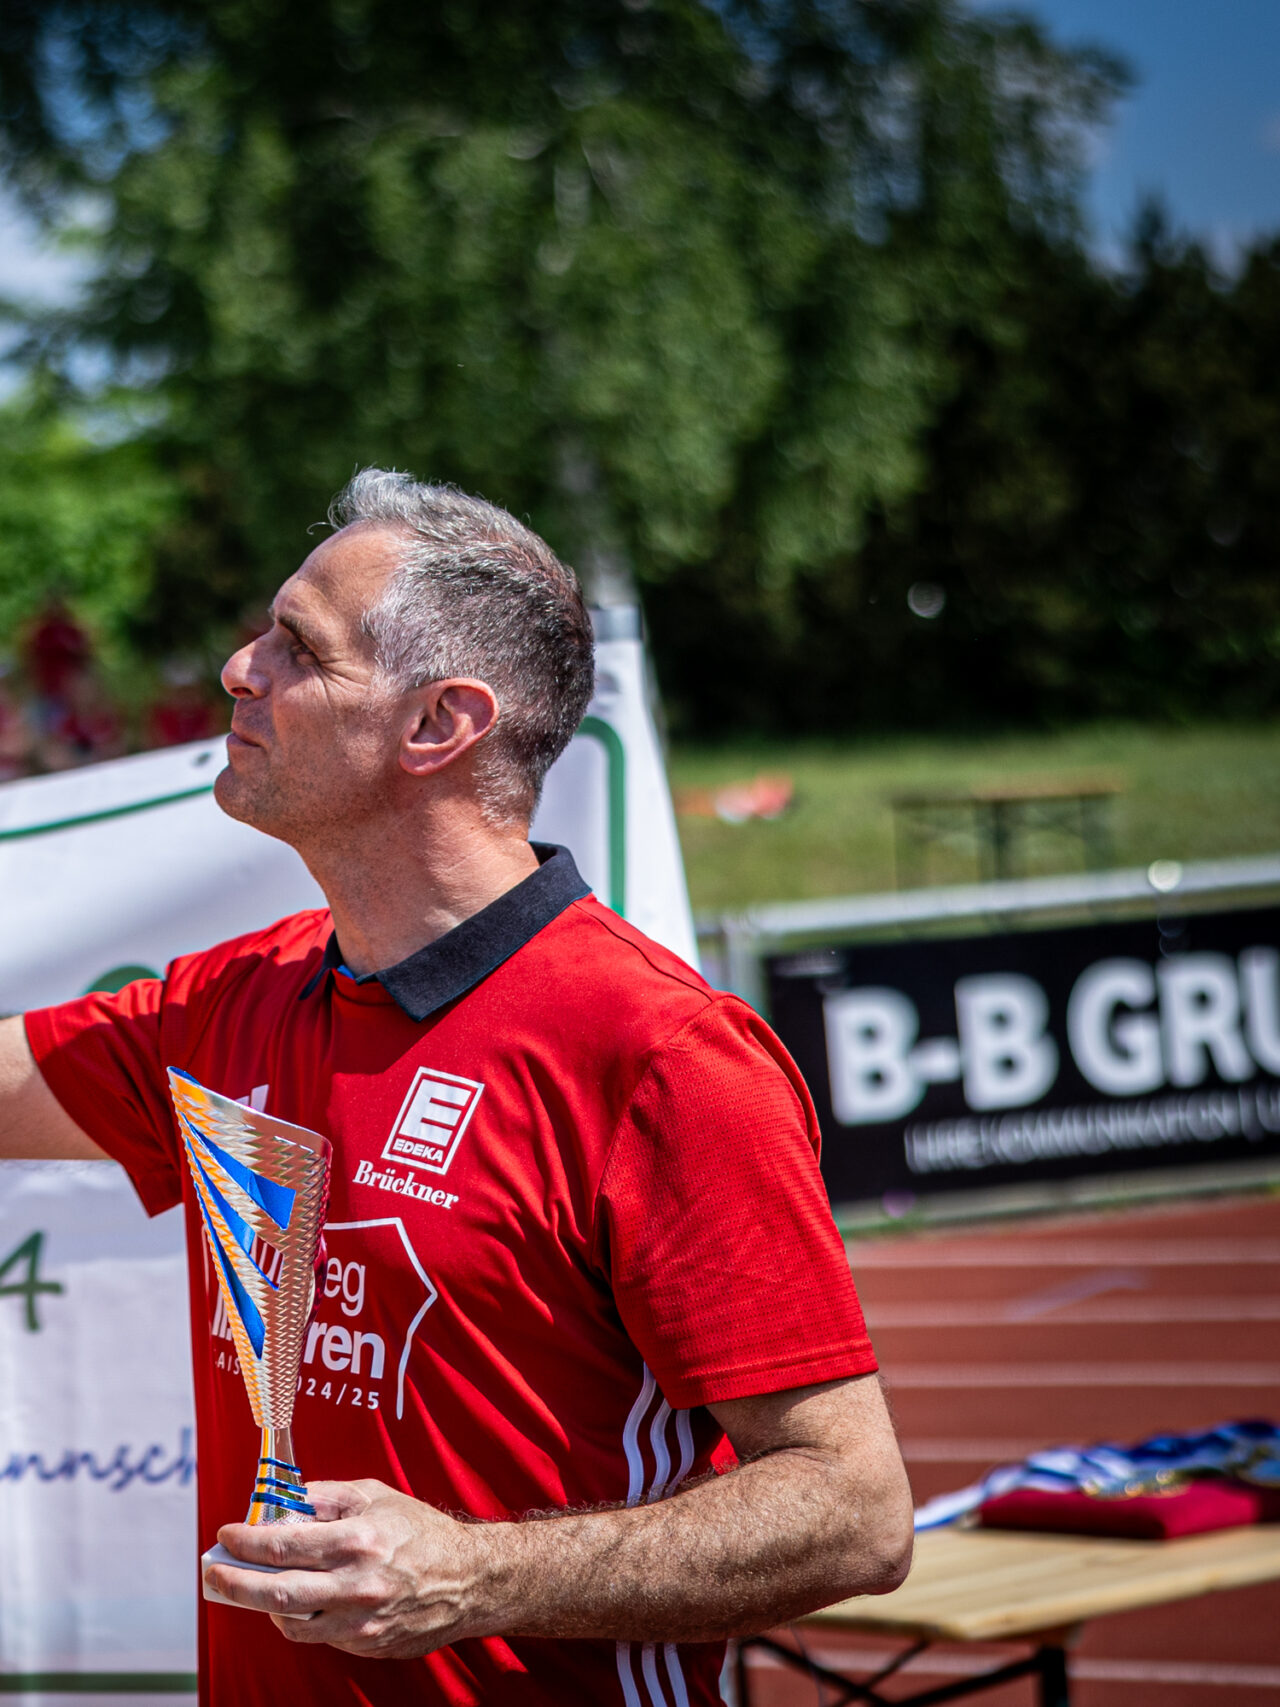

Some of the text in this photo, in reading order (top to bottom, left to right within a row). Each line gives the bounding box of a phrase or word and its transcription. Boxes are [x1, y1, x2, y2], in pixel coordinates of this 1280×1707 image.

[824, 972, 1059, 1125] B-B
[398, 1078, 472, 1147] E
[392, 1137, 444, 1163] EDEKA
[351, 1159, 460, 1210] Brückner
